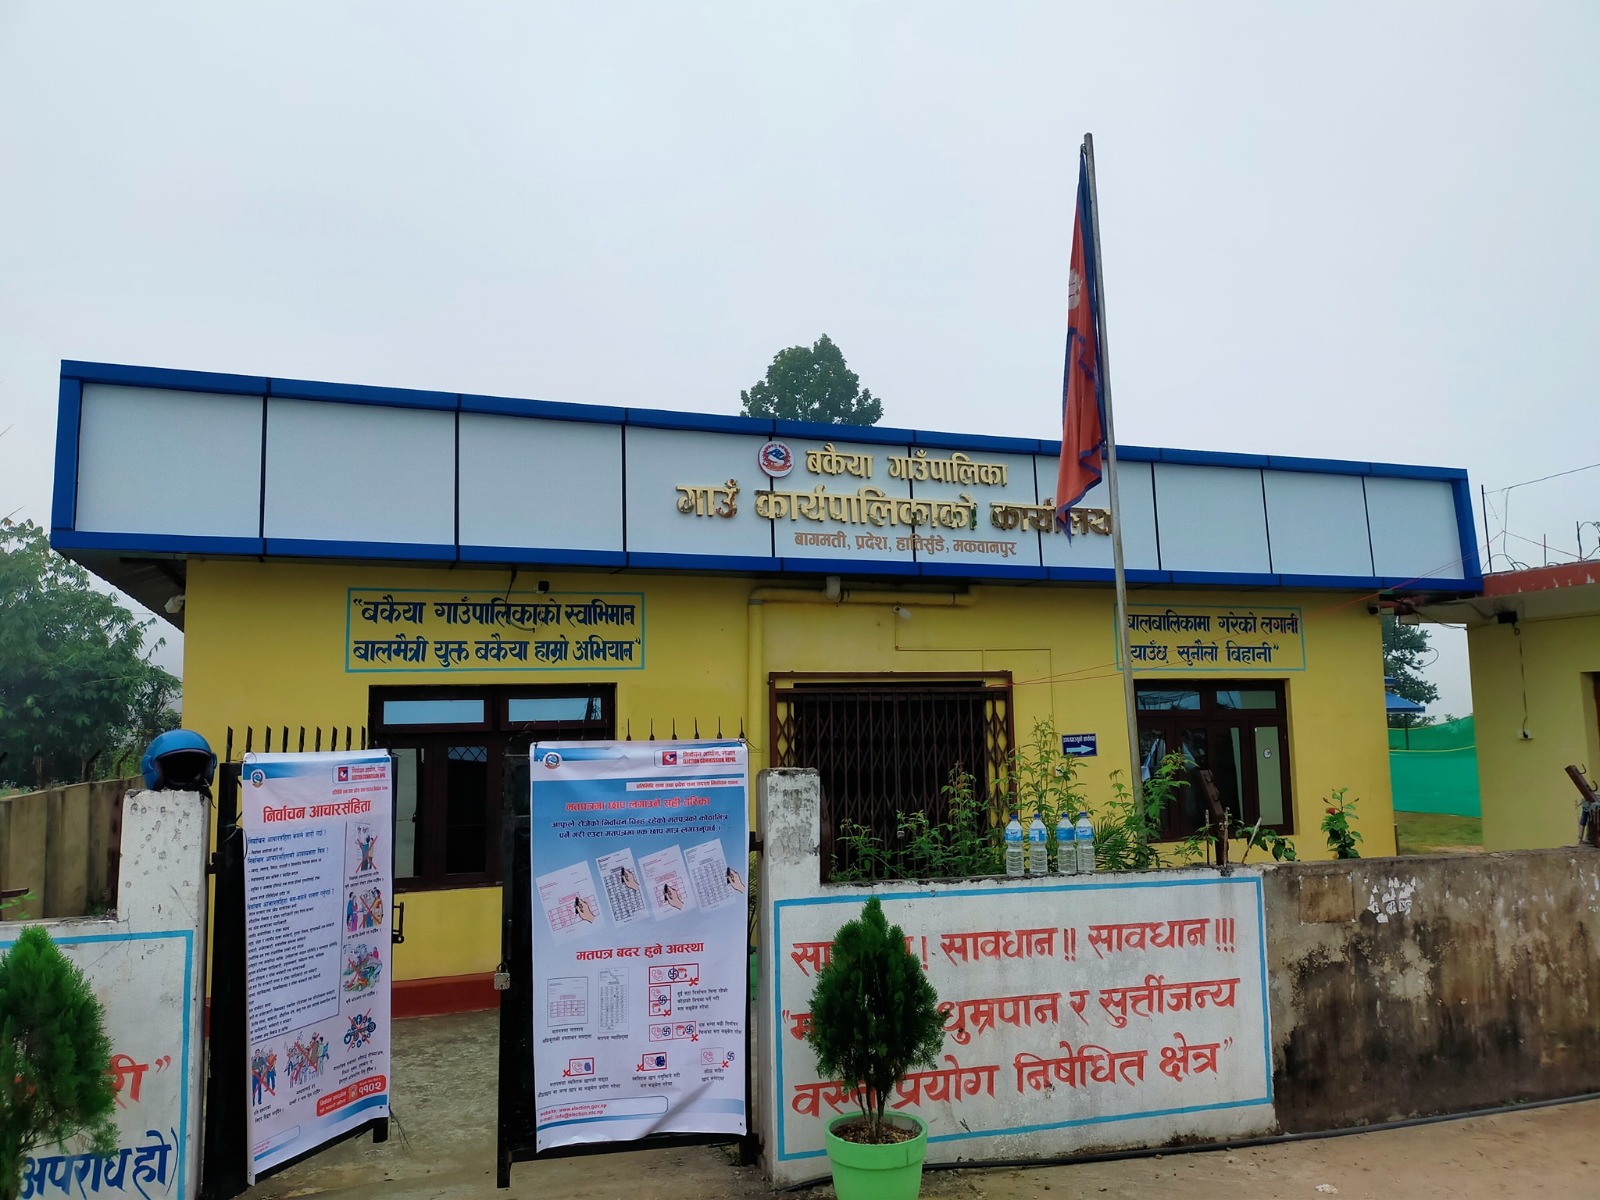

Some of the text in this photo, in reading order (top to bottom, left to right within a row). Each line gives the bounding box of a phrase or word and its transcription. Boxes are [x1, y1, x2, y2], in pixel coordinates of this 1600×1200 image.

[806, 442, 1008, 487] बकैया गाउँपालिका
[676, 478, 740, 519] गाउँ
[755, 484, 978, 531] कार्यपालिकाको
[794, 532, 851, 550] बागमती,
[855, 532, 892, 552] प्रदेश,
[953, 539, 1017, 558] मकवानपुर
[433, 596, 561, 627] गाउँपालिकाको
[565, 599, 635, 627] स्वाभिमान
[1217, 611, 1257, 635] गरेको
[1262, 612, 1299, 635] लगानी
[353, 633, 429, 664] बालमैत्री
[434, 640, 470, 668] युक्त
[474, 633, 530, 662] बकैया
[534, 634, 569, 664] हाम्रो
[1177, 639, 1219, 667] सुनौलो
[263, 797, 372, 824] निर्वाचन आचारसंहिता
[565, 795, 710, 812] मतपत्रमा छाप लगाउने सही तरिका
[576, 942, 704, 961] मतपत्र बदर हुने अवस्था
[1069, 989, 1090, 1026] र
[891, 1054, 1001, 1110] प्रयोग
[1013, 1040, 1148, 1096] निषेधित
[358, 1081, 382, 1095] ११०२
